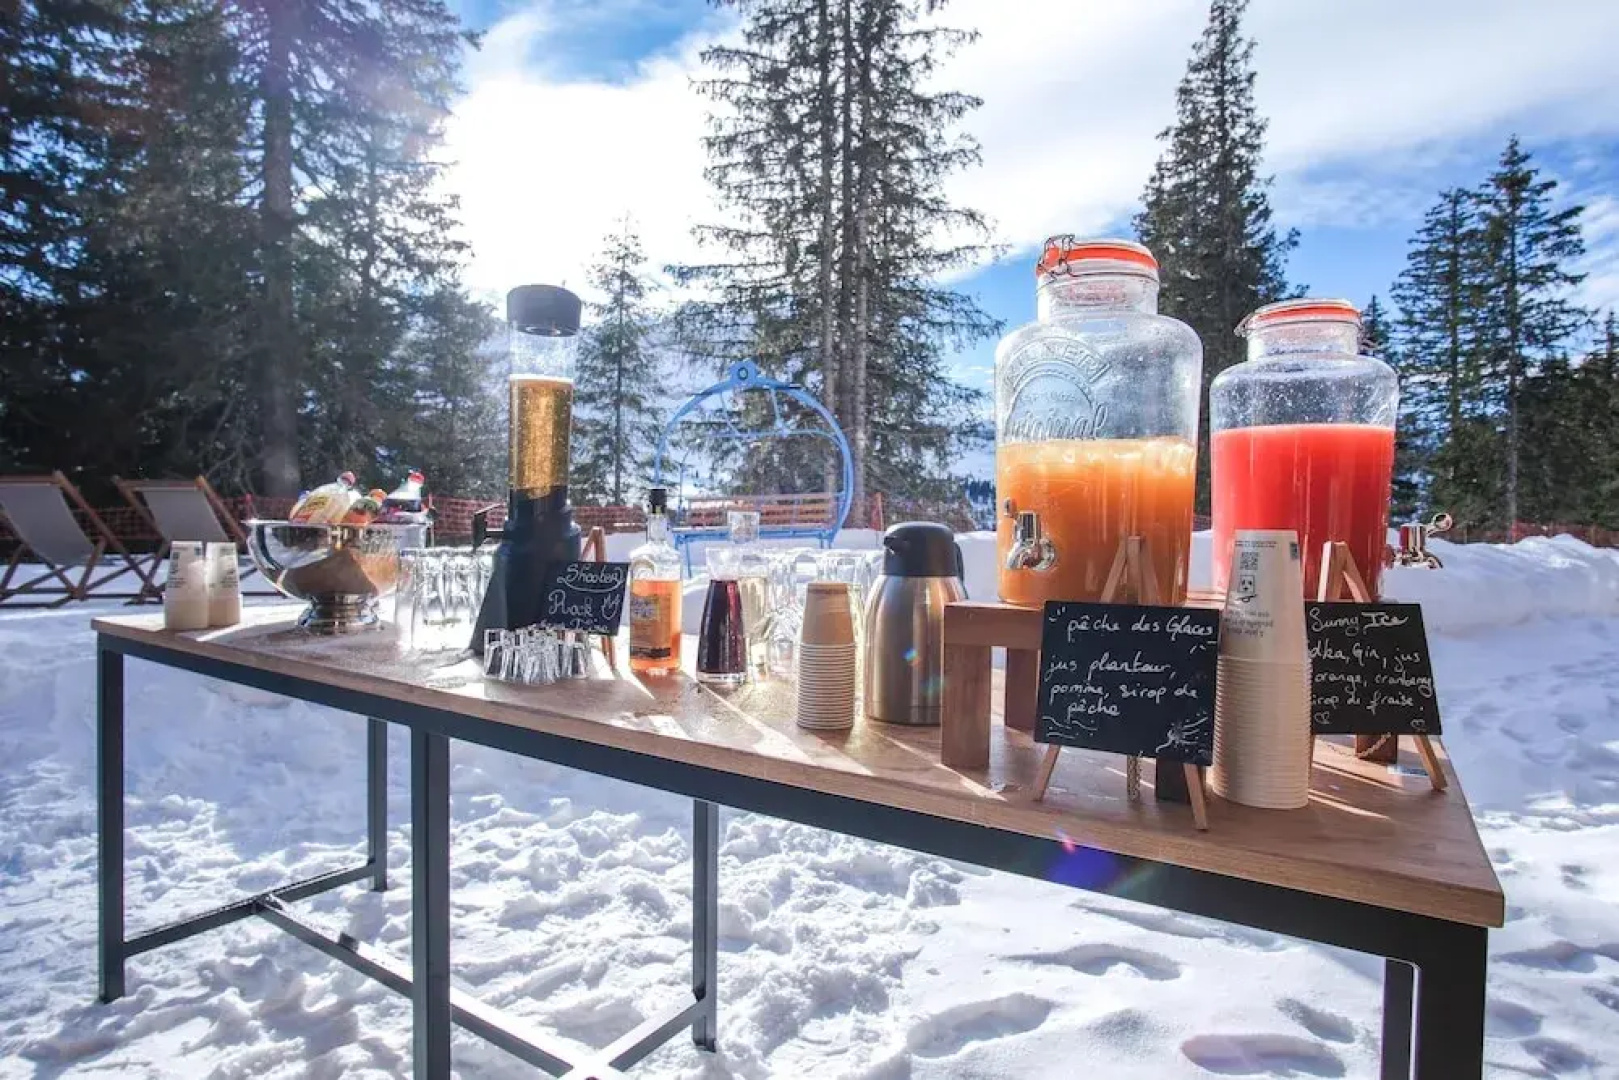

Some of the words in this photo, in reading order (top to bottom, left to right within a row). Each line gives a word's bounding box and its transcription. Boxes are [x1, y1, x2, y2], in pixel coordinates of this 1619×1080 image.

[1067, 614, 1120, 642] pêche
[1131, 614, 1160, 632] des
[1309, 607, 1359, 636] Sunny
[1044, 655, 1078, 682] jus
[1308, 638, 1350, 664] dka,
[1394, 647, 1421, 672] jus
[1120, 683, 1167, 704] sirop
[1174, 683, 1198, 699] de
[1312, 694, 1339, 709] irop
[1067, 698, 1121, 723] pêche
